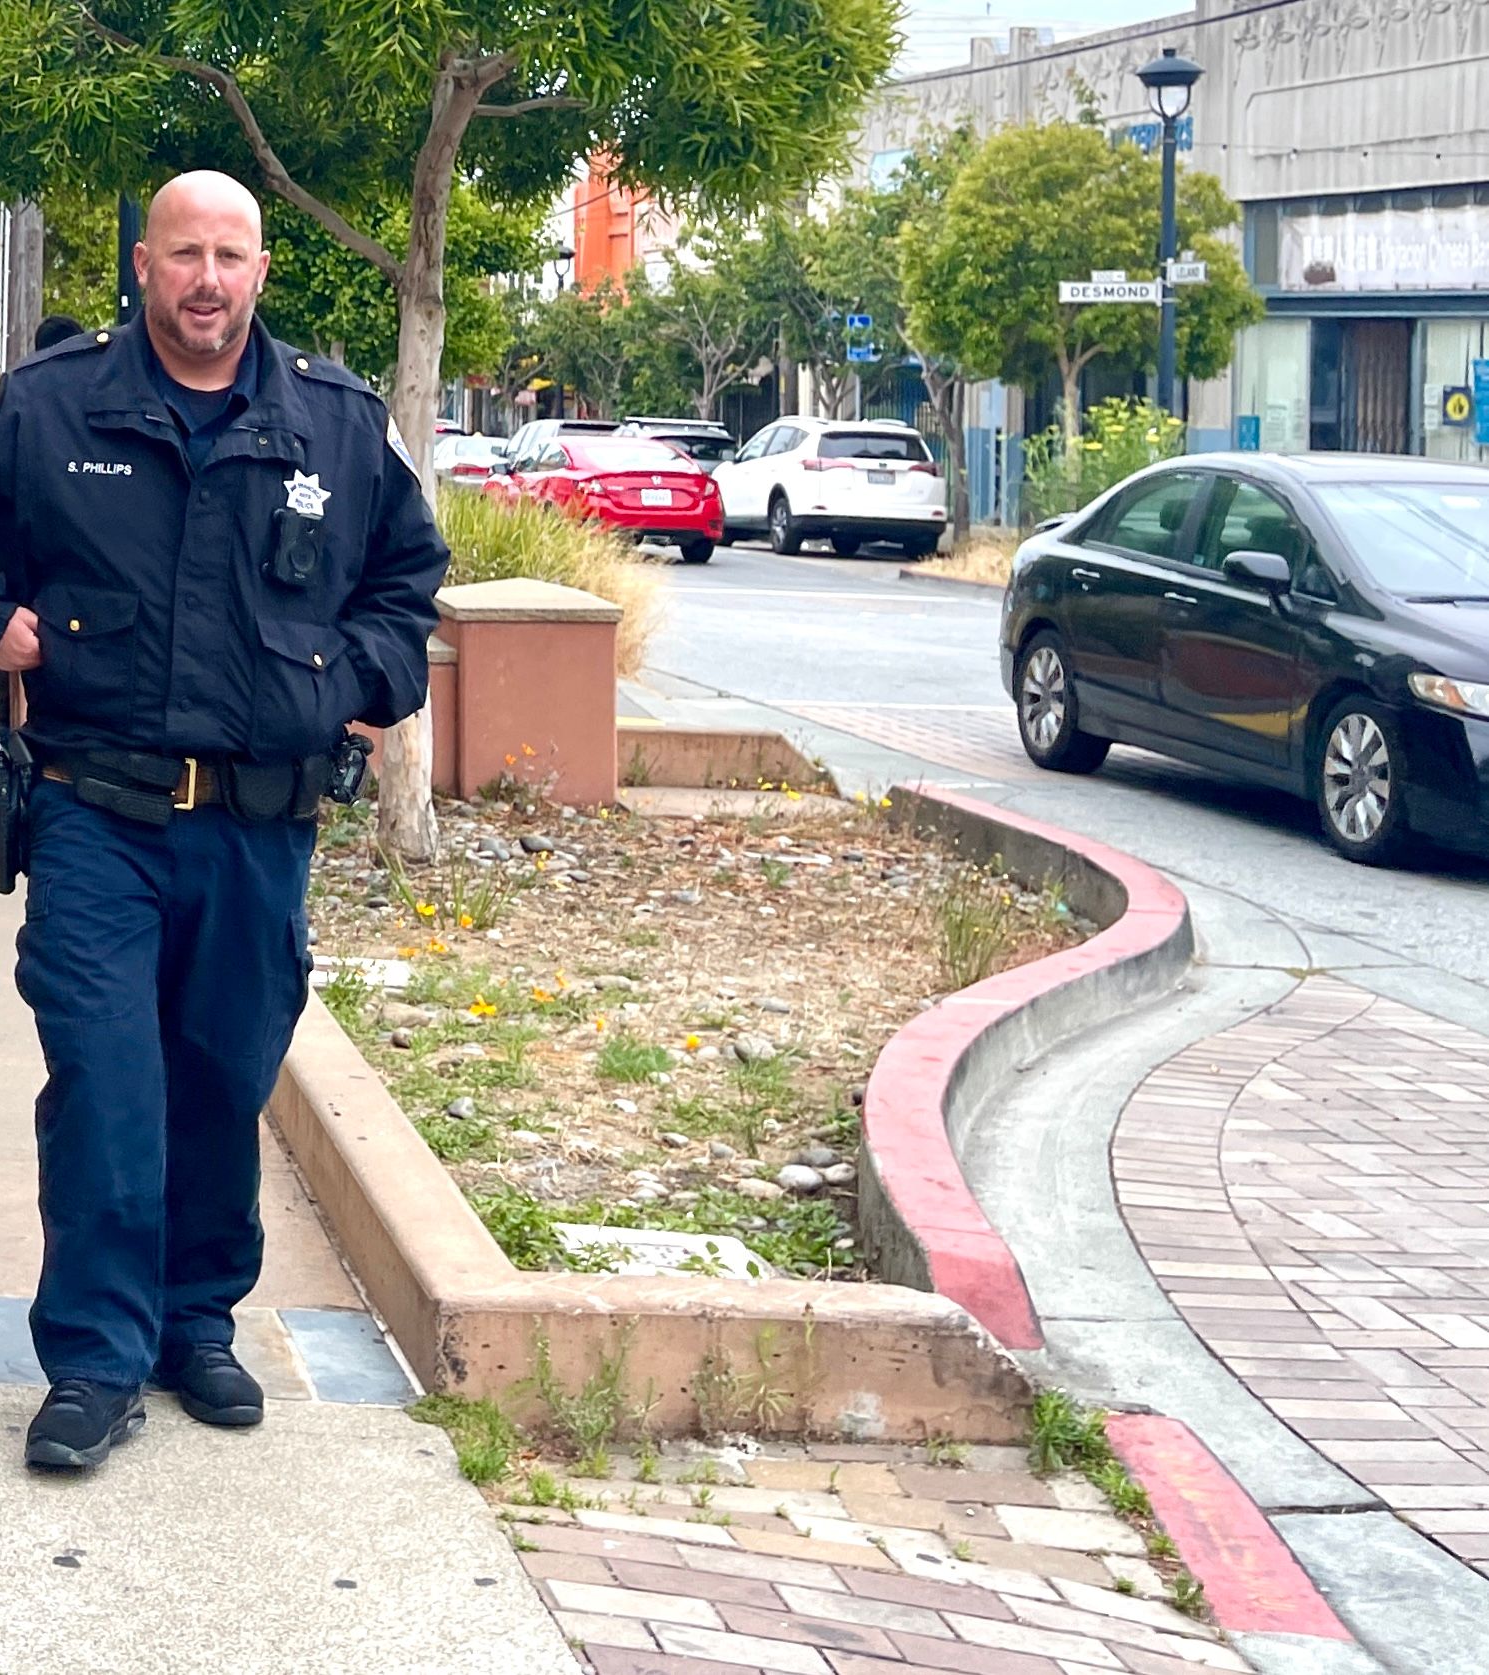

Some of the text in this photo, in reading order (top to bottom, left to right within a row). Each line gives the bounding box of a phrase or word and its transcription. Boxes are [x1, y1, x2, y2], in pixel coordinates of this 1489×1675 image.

[1070, 286, 1150, 298] DESMOND
[67, 462, 133, 476] S. PHILLIPS
